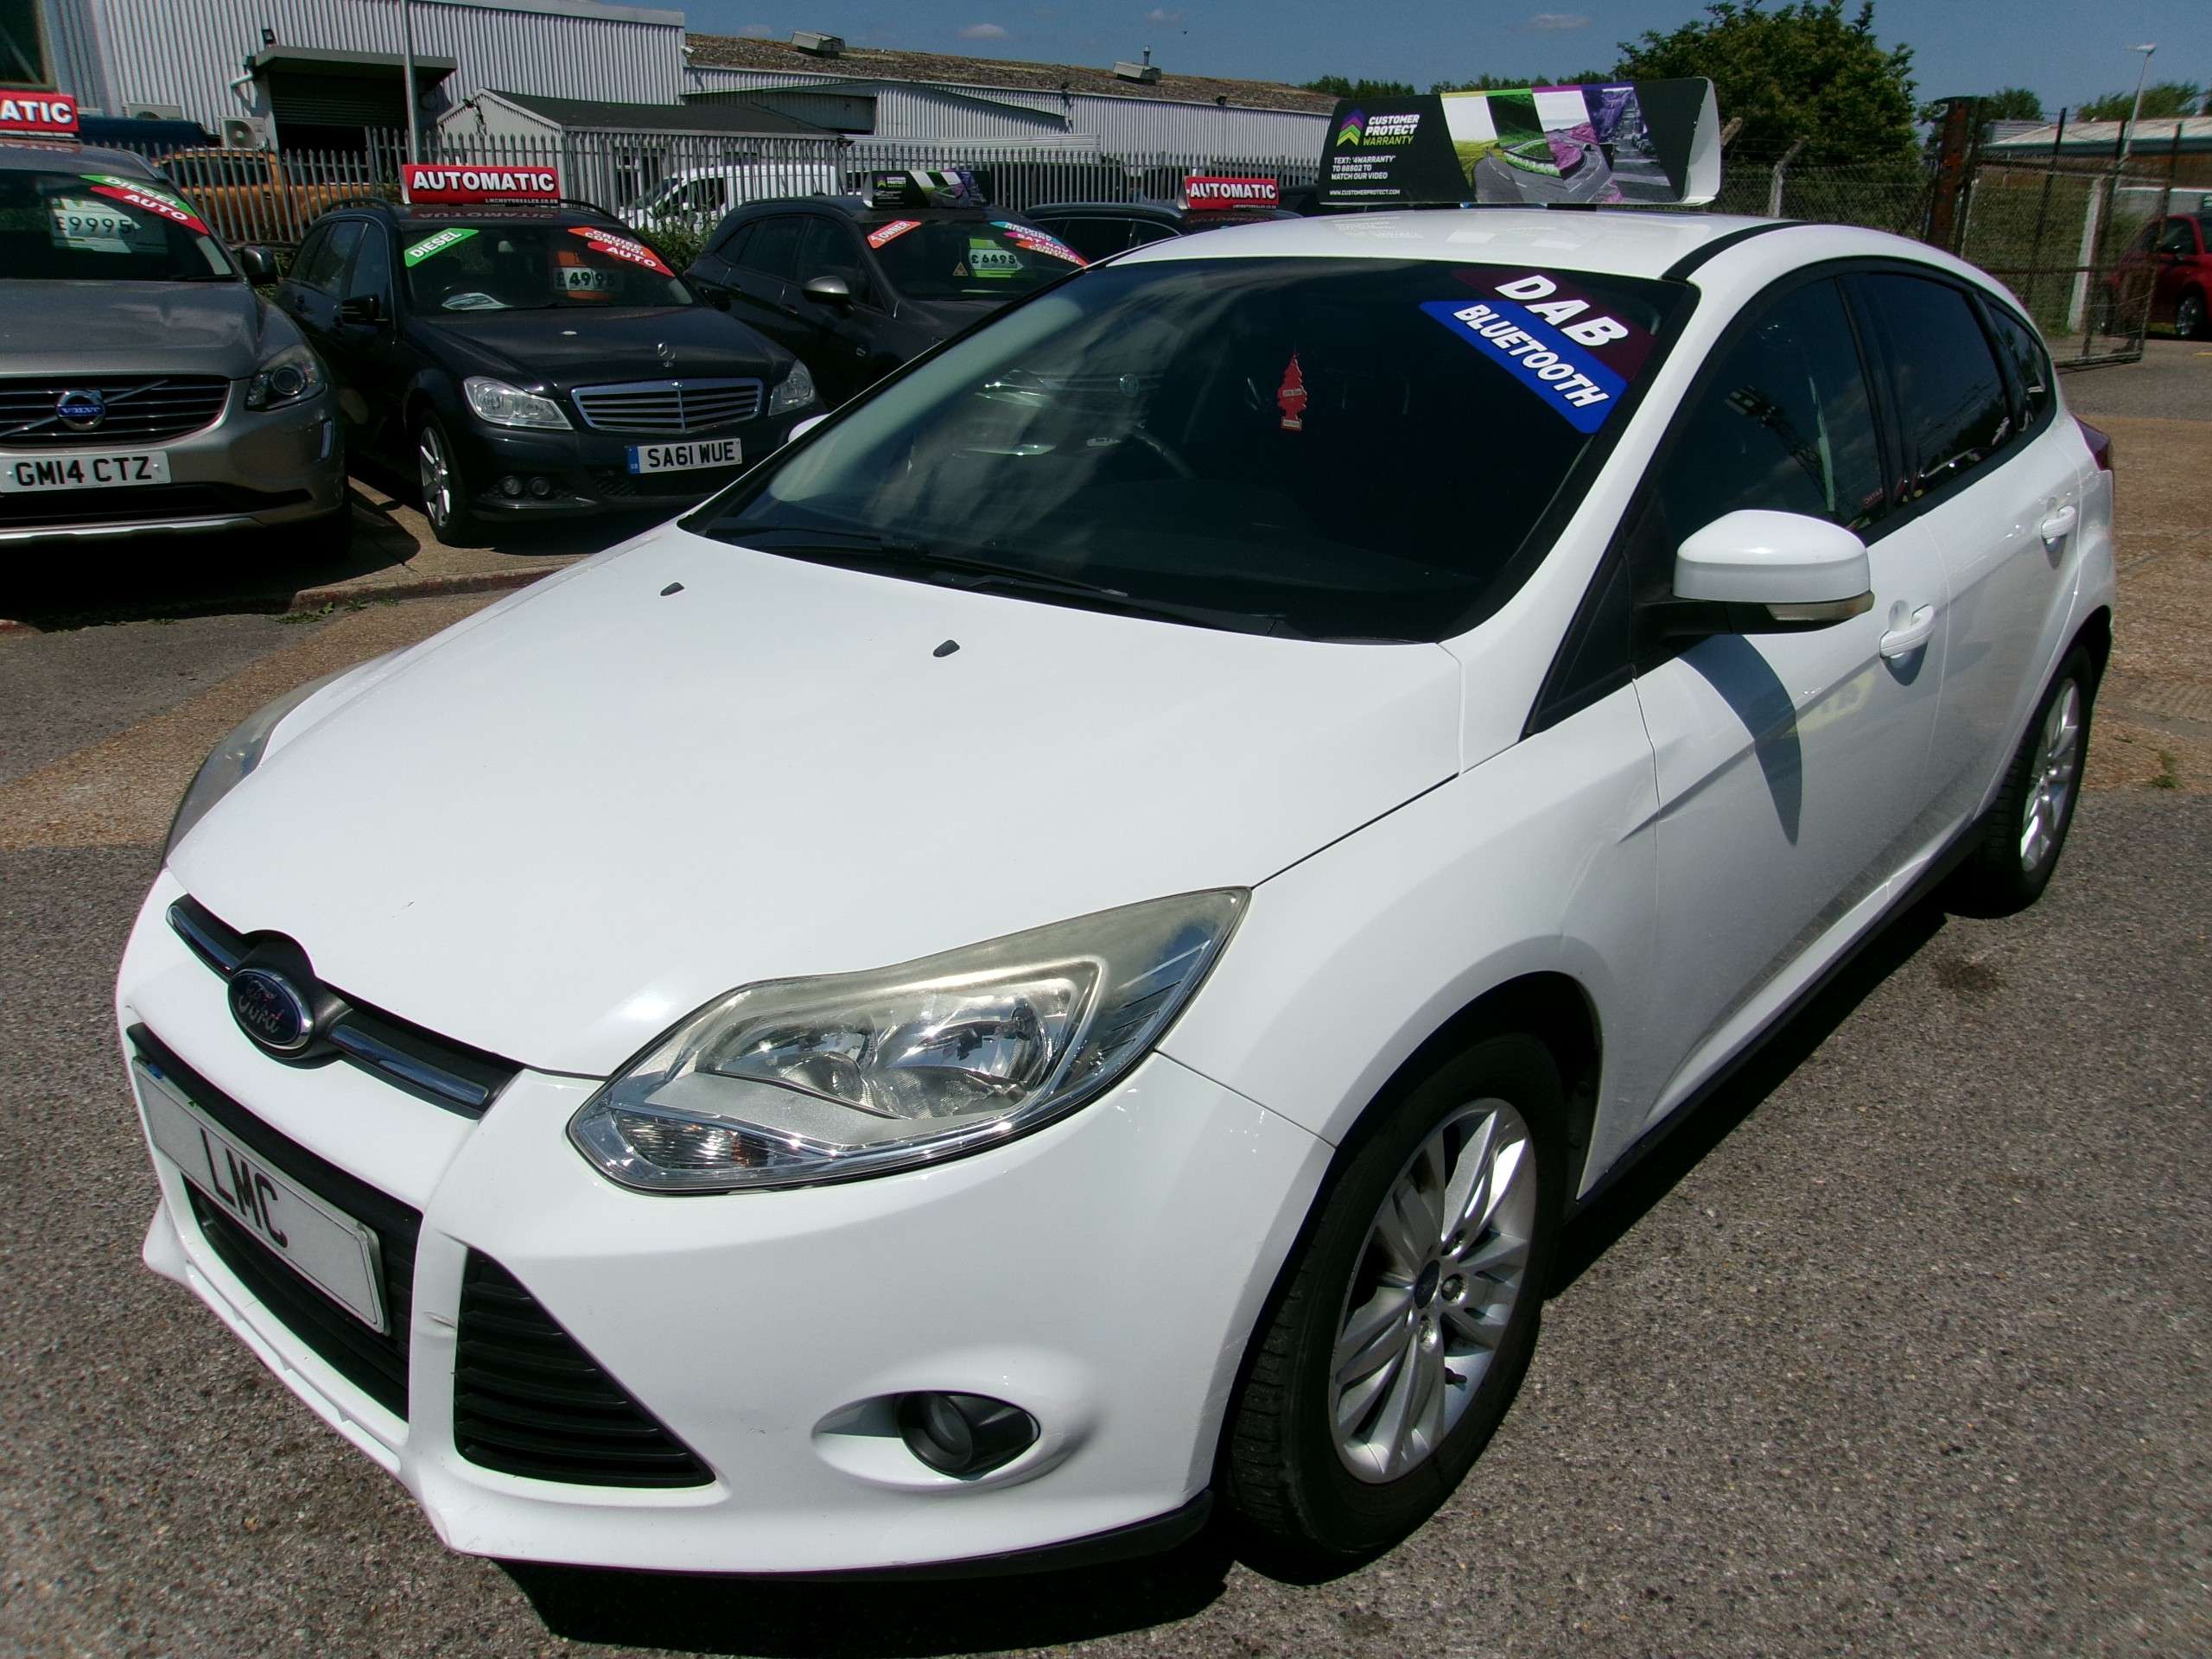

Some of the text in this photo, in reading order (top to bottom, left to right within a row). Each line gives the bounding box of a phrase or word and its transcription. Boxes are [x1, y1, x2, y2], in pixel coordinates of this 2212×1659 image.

[1365, 124, 1417, 137] PROTECT
[1368, 114, 1420, 125] CUSTOMER
[1363, 136, 1414, 146] WARRANTY
[104, 176, 180, 208] DIESEL
[413, 171, 555, 191] AUTOMATIC
[1190, 182, 1276, 199] AUTOMATIC
[124, 194, 188, 220] AUTO
[409, 230, 462, 258] DIESEL
[584, 232, 646, 257] CONTROL
[593, 229, 643, 250] CRUISE
[606, 247, 657, 267] AUTO
[1494, 275, 1629, 346] DAB
[1452, 304, 1610, 408] BLUETOOTH
[647, 441, 735, 467] SA61 WUE
[16, 455, 152, 486] GM14 CTZ
[200, 1126, 289, 1250] LMC
